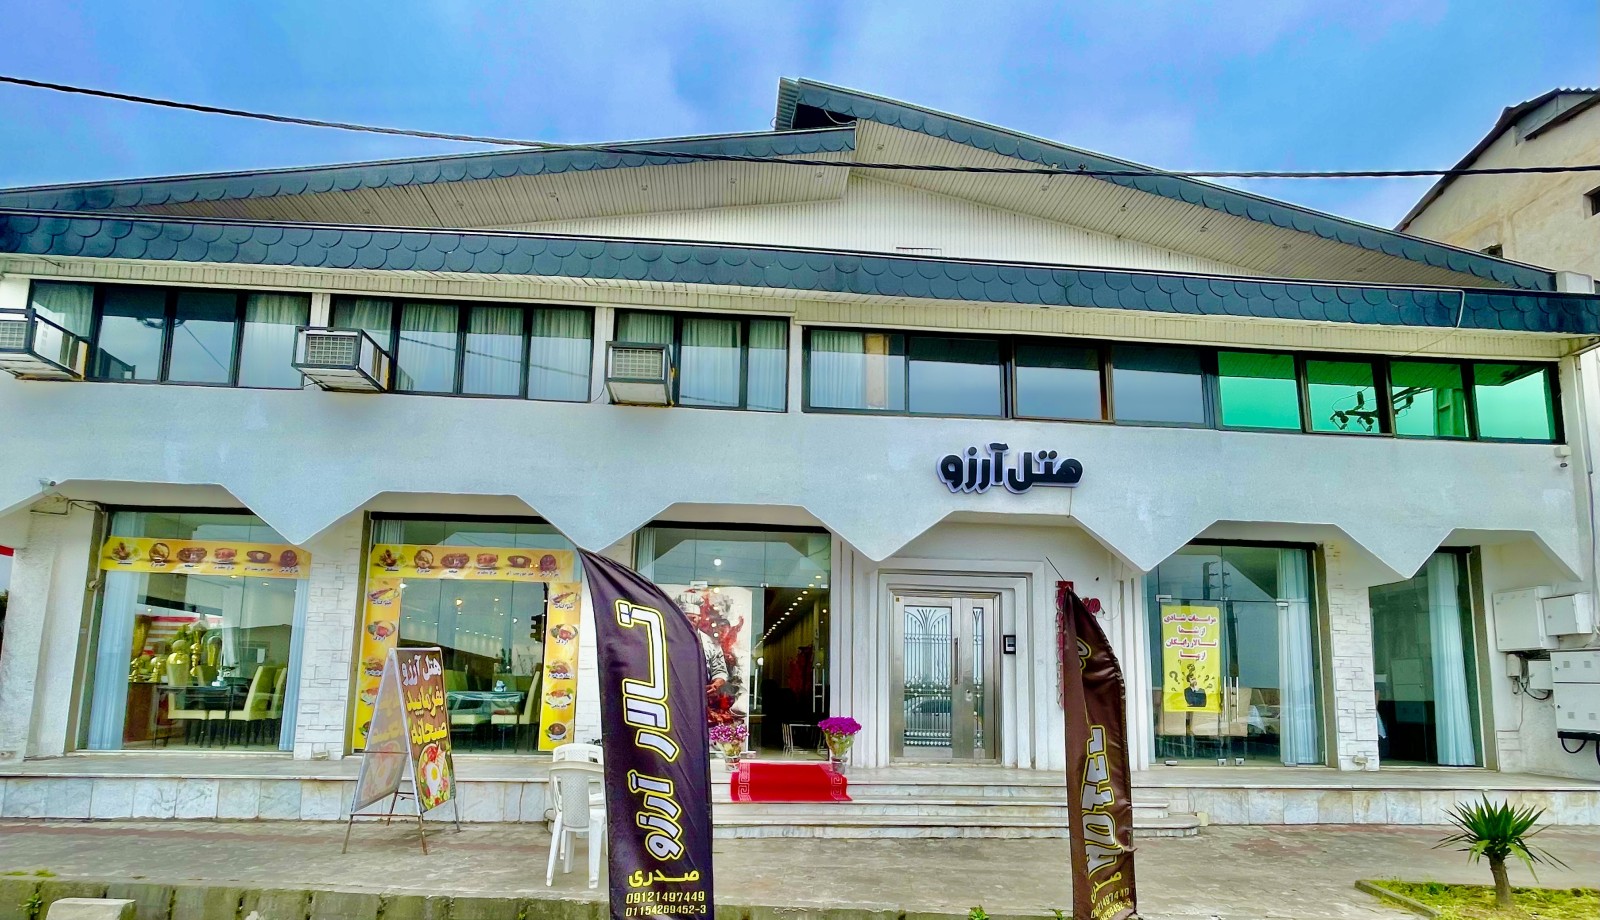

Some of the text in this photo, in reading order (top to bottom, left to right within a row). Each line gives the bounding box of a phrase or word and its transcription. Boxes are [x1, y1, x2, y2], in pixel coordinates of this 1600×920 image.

[940, 442, 1083, 491] هتل آرزو
[1164, 614, 1187, 622] شادی
[1178, 625, 1200, 633] شما
[1166, 638, 1217, 648] تالار رایگان
[402, 655, 442, 686] هتل آرزو
[406, 685, 444, 717] بفرمایید
[411, 718, 447, 745] صبحانه
[615, 599, 683, 860] تالار آرزو
[628, 869, 700, 887] صدری
[625, 891, 705, 904] 09121497449
[625, 905, 706, 917] 01154269452-3
